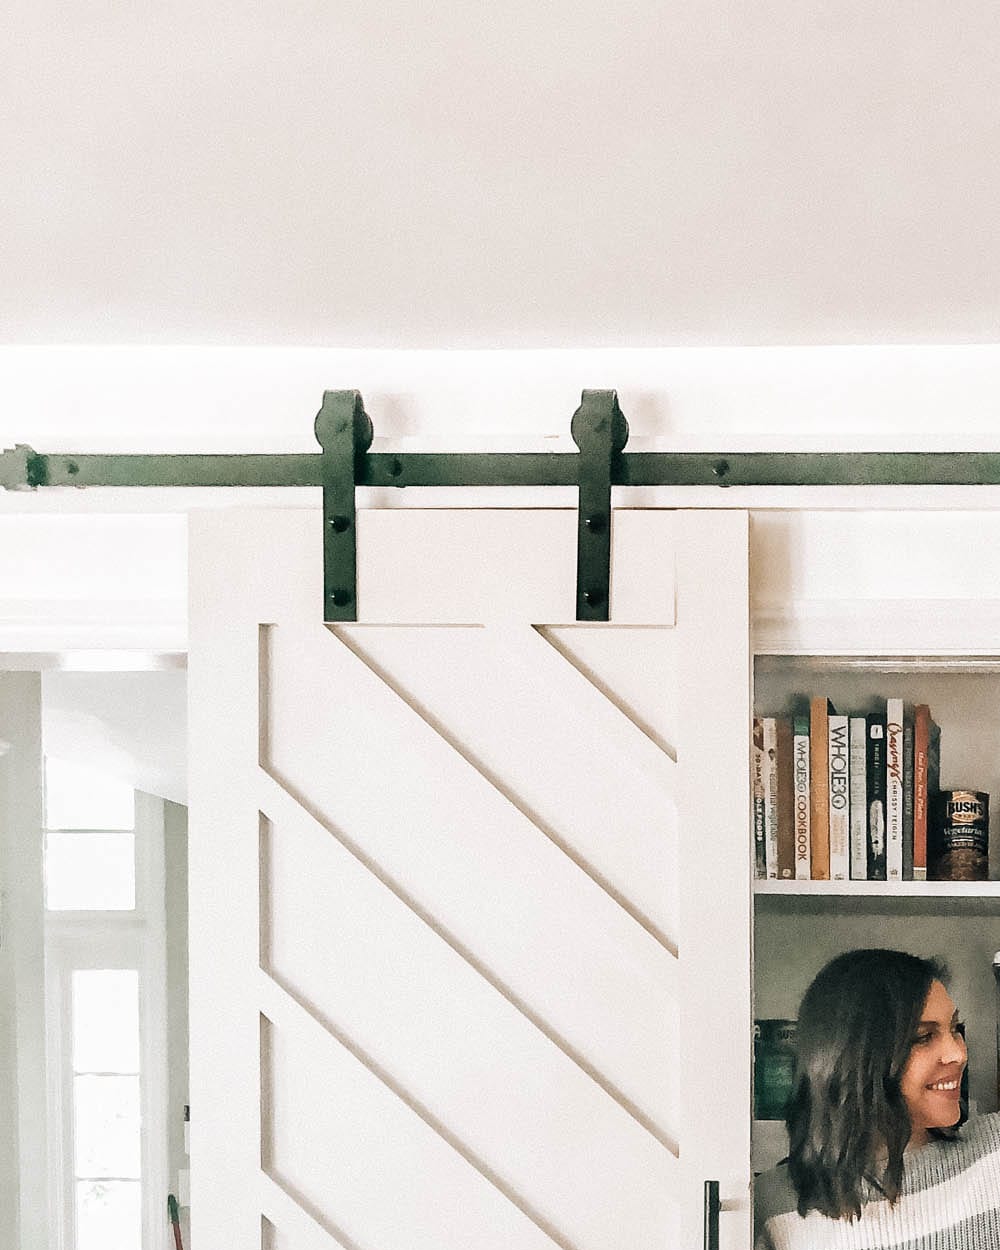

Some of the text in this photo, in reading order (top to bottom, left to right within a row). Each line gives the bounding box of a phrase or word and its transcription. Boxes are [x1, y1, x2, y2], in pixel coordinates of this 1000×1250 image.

[830, 725, 847, 810] WHOLE30
[887, 723, 904, 786] Cravings
[796, 741, 807, 861] WHOLE30 COOKBOOK
[947, 801, 984, 816] BUSH'S
